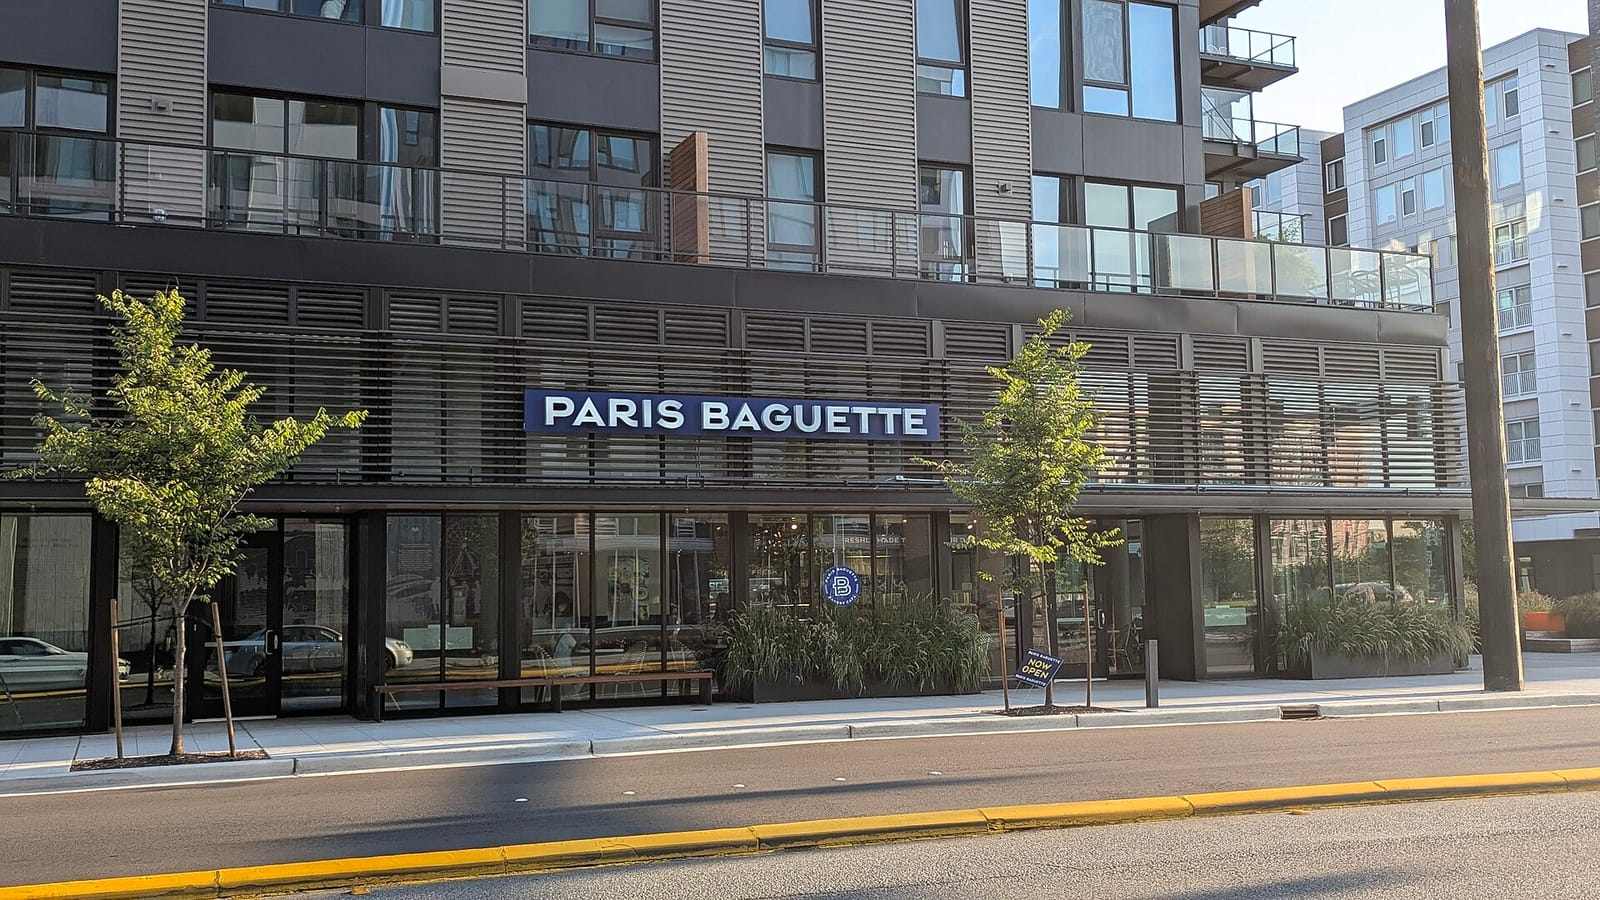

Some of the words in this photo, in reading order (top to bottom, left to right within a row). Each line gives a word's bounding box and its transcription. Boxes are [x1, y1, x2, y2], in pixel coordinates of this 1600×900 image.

[544, 396, 685, 429] PARIS
[701, 401, 928, 435] BAGUETTE
[836, 567, 858, 582] BAGUETTE
[1027, 658, 1052, 670] NOW
[1040, 654, 1061, 664] BAGUETTE
[1022, 665, 1049, 679] OPEN
